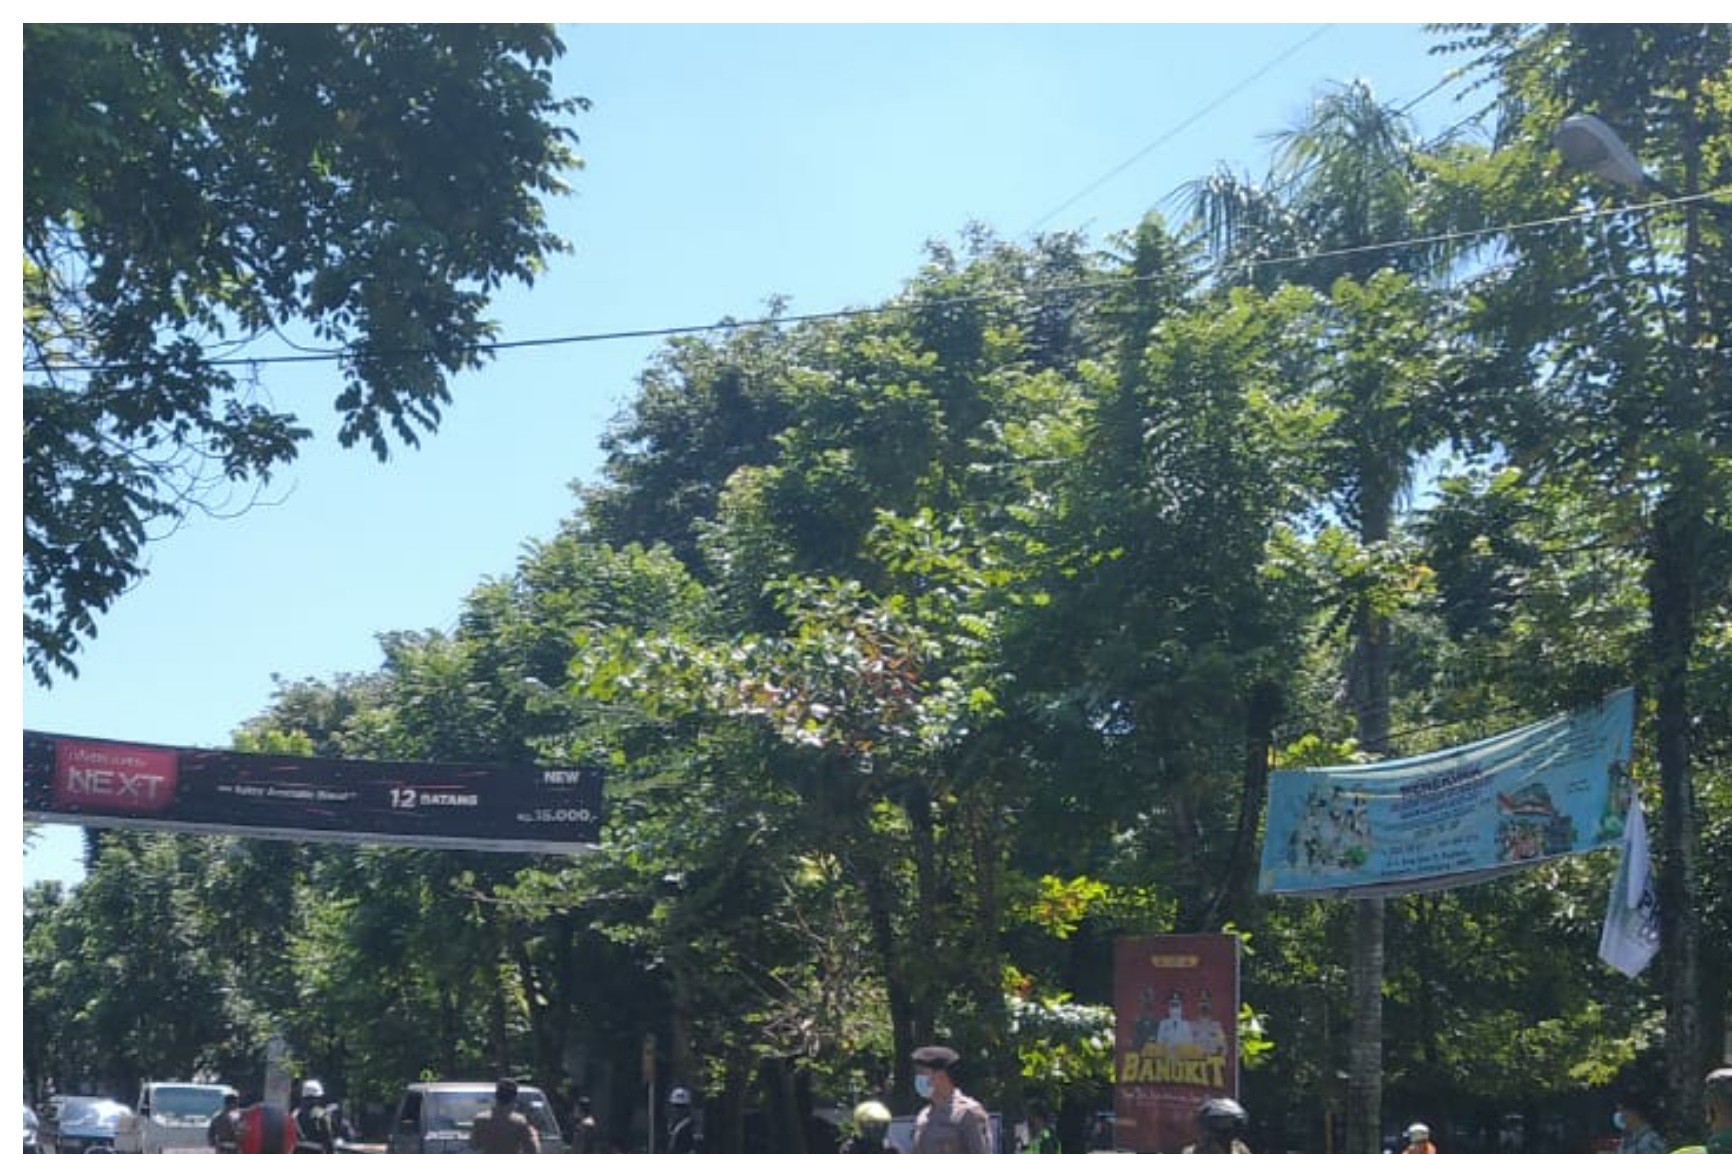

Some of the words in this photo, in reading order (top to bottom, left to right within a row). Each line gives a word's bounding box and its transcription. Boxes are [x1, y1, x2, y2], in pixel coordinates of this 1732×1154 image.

[67, 766, 165, 799] NEXT
[543, 771, 580, 784] NEW
[390, 788, 416, 808] 12
